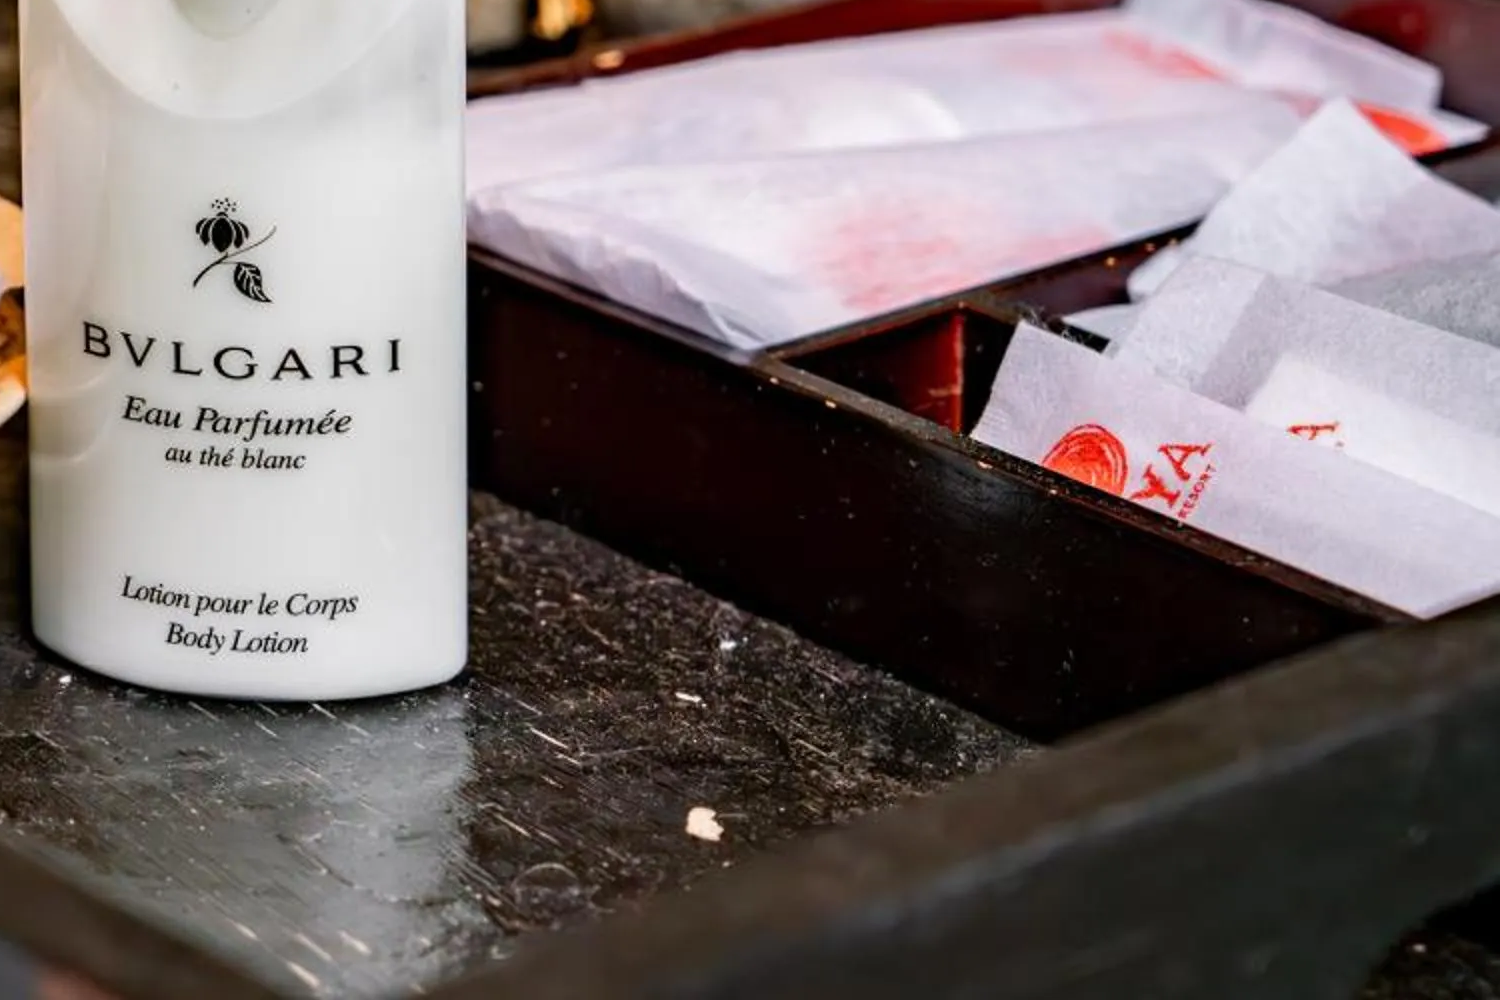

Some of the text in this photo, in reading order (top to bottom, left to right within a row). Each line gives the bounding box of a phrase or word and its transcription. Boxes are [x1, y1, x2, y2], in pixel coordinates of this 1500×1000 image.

[82, 320, 403, 382] BVLGARI
[121, 395, 354, 443] Eau Parfumée
[164, 445, 308, 470] au thé blanc
[120, 575, 360, 622] Lotion pour le Corps
[164, 621, 310, 656] Body Lotion
